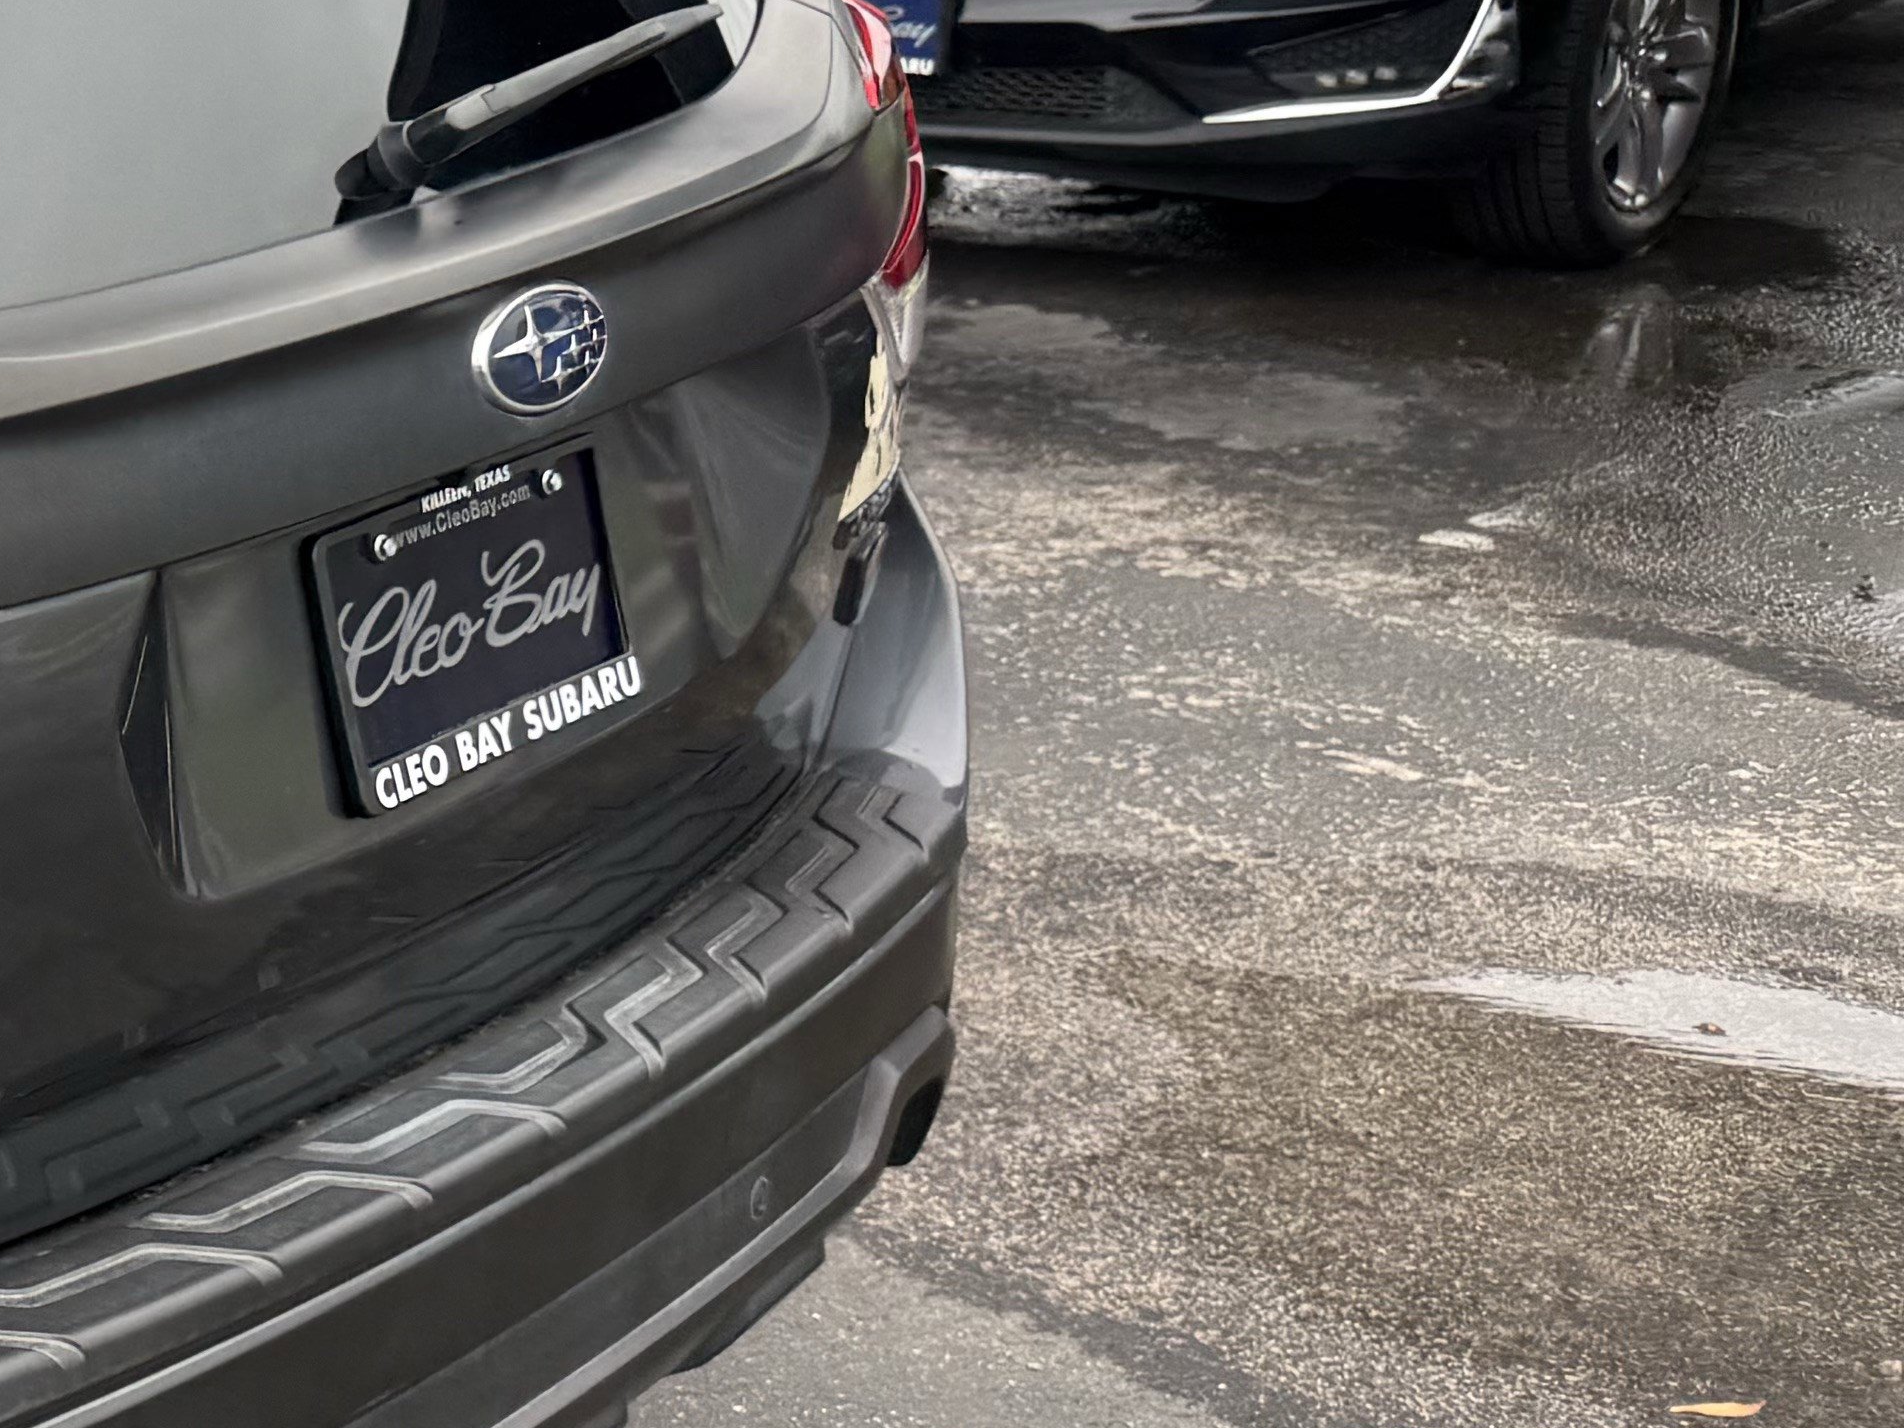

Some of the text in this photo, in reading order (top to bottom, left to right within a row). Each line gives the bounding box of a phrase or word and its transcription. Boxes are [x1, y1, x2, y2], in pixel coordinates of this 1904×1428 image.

[475, 465, 511, 492] TEXAS
[338, 539, 600, 707] Cleo Bay
[376, 656, 641, 809] CLEO BAY SUBARU
